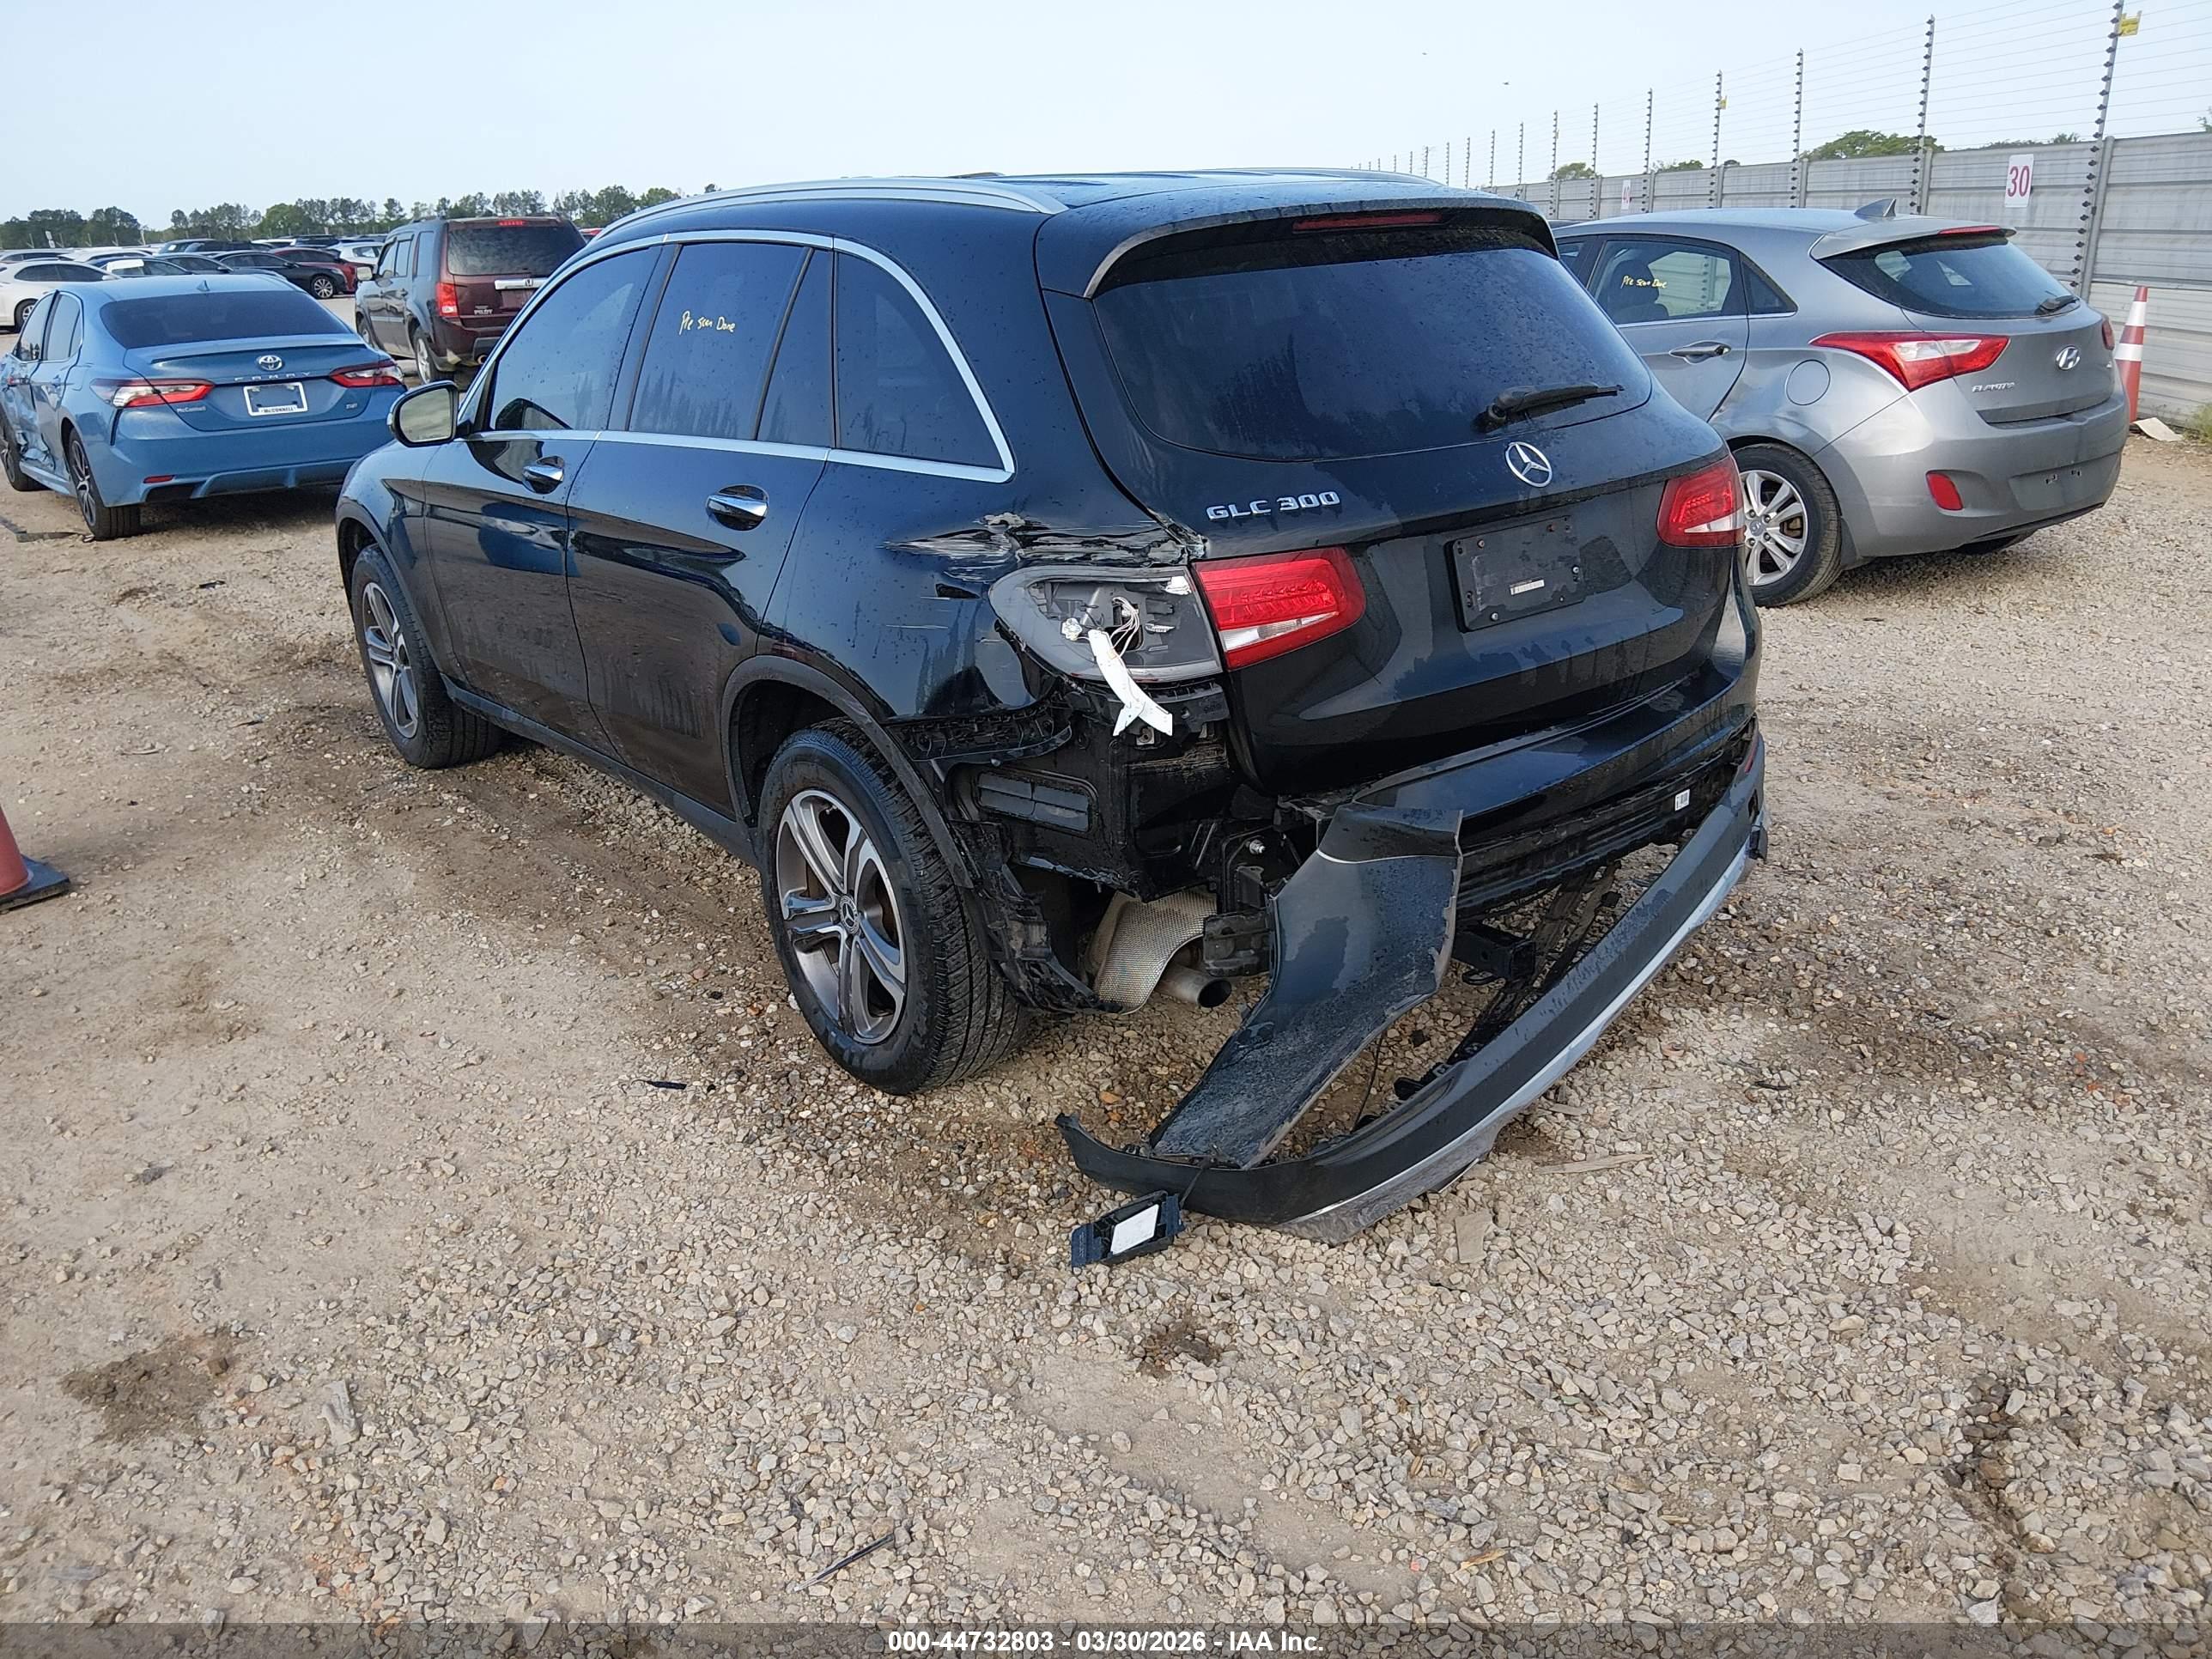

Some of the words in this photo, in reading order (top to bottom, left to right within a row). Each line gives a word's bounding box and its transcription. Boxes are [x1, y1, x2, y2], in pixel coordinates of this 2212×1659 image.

[2007, 165, 2030, 198] 30
[1206, 500, 1272, 520] GLC
[1276, 490, 1340, 512] 300
